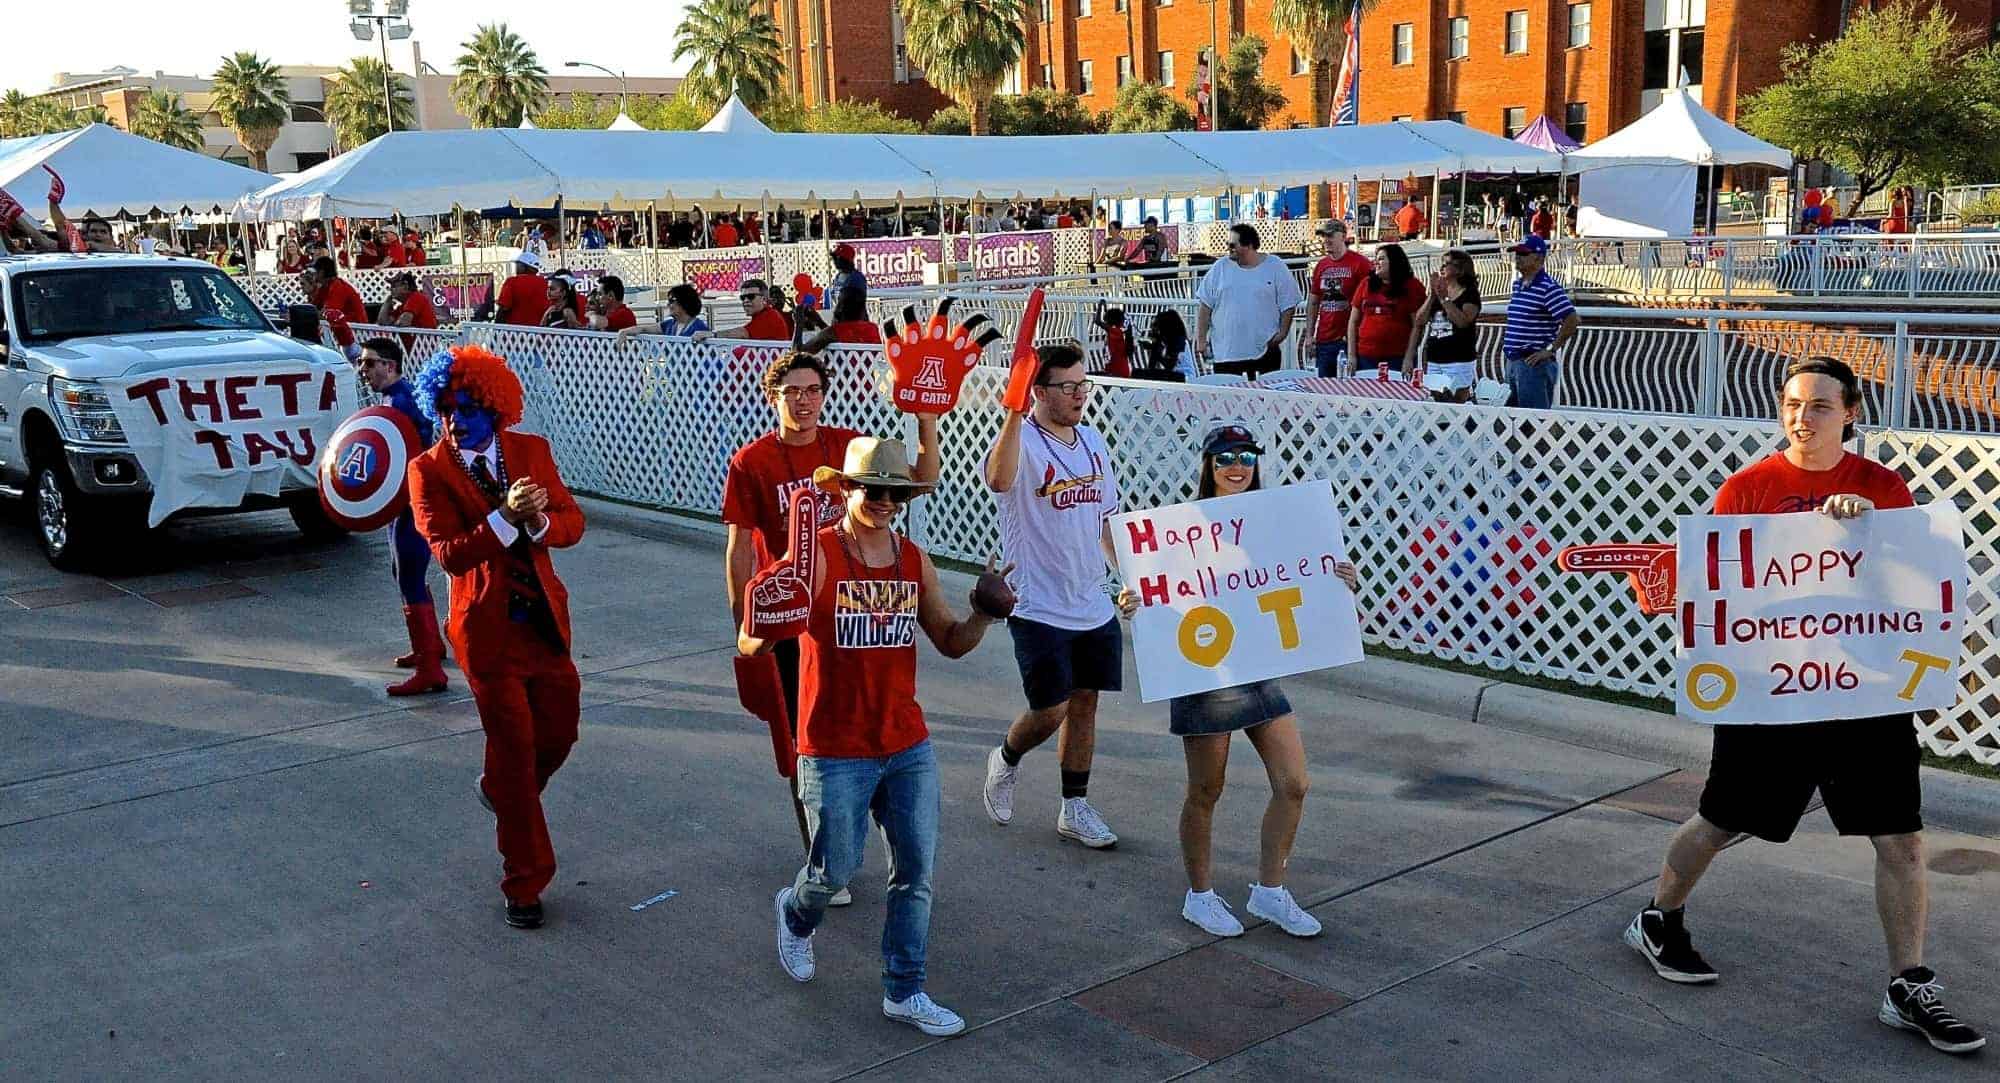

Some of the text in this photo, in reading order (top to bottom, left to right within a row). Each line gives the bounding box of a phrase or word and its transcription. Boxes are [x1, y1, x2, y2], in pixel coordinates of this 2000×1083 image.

[900, 272, 924, 283] CASIN
[912, 356, 946, 390] A
[126, 370, 338, 426] THETA
[900, 388, 952, 405] GO CATS!
[195, 428, 316, 470] TAU
[339, 442, 373, 482] A
[799, 503, 811, 578] WILDCATS
[1126, 518, 1243, 560] Happy
[1573, 553, 1651, 565] WILDCATS
[1140, 555, 1337, 607] Halloween
[757, 606, 808, 619] TRANSFER
[835, 613, 917, 649] WILDCATS
[1770, 661, 1860, 696] 2016
